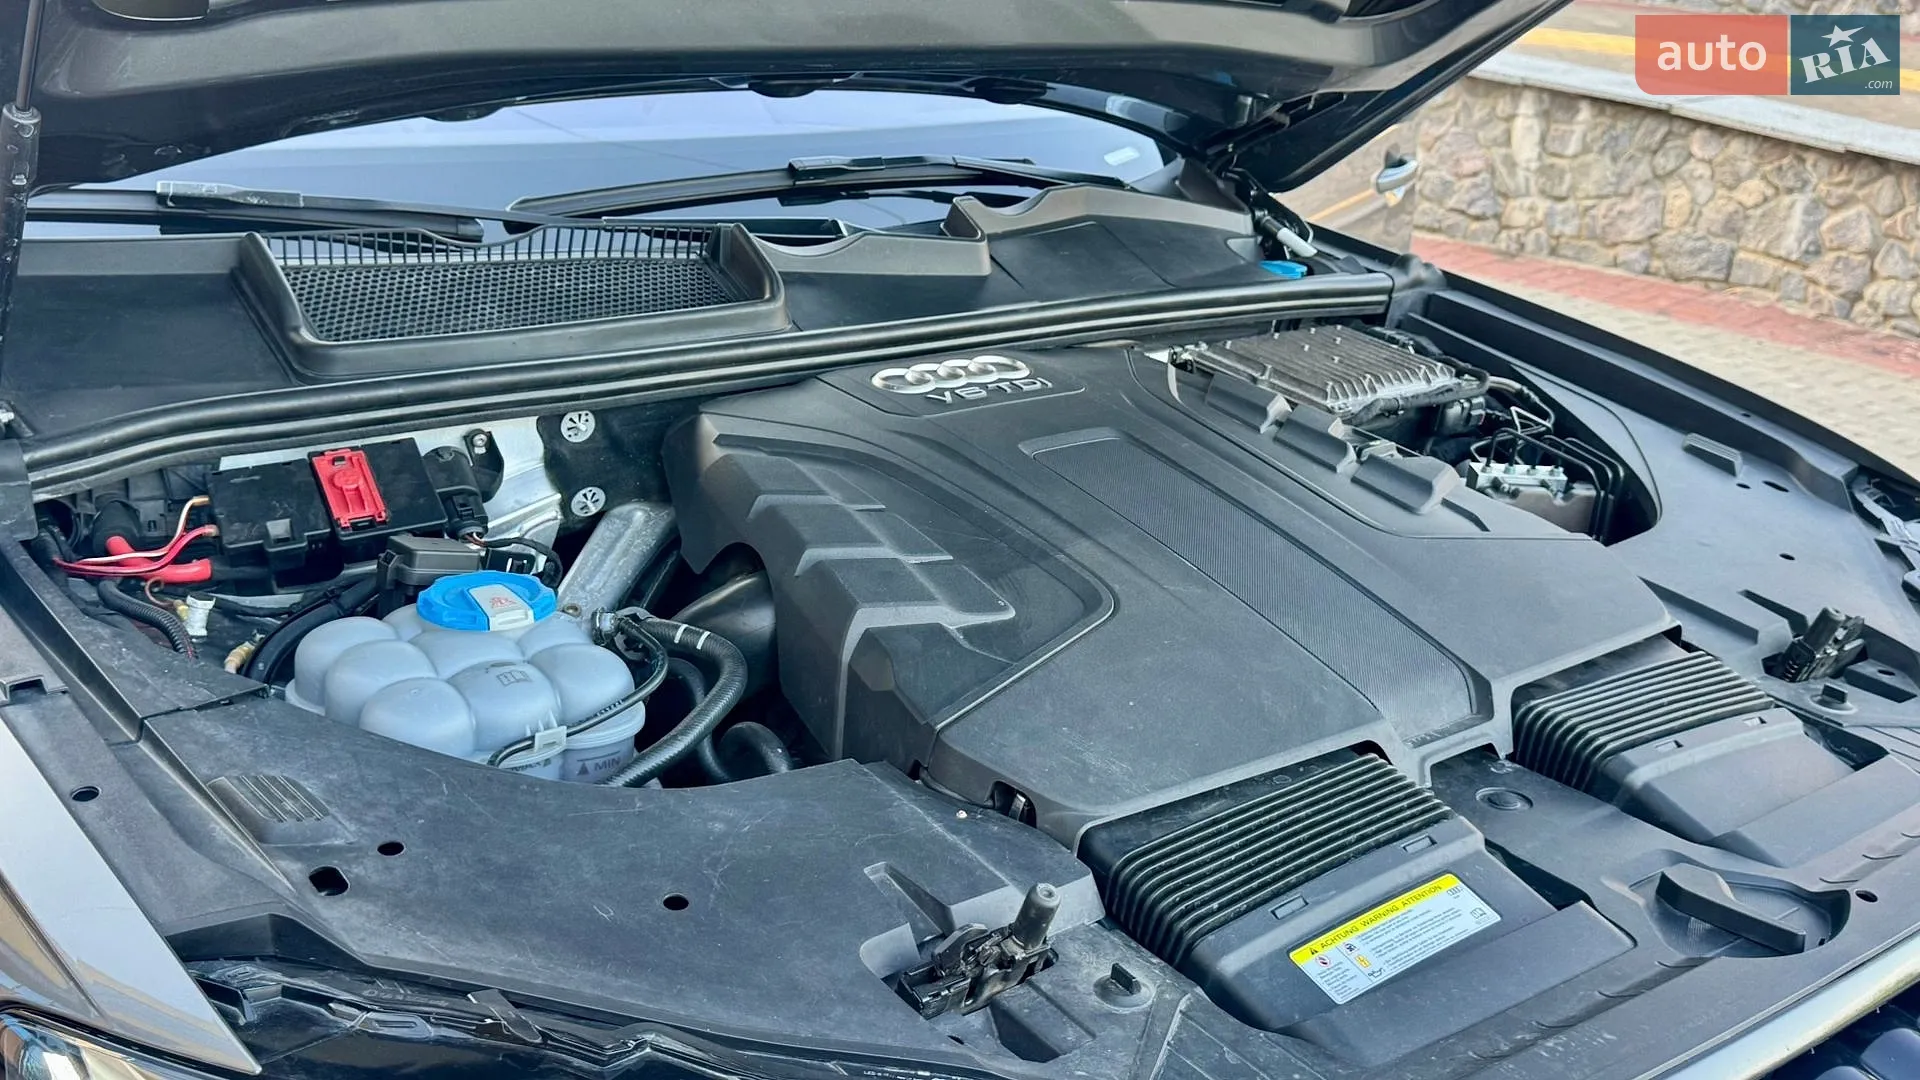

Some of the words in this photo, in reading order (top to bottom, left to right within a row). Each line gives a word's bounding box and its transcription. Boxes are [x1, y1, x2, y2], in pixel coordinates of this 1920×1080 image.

[926, 386, 987, 404] V6
[986, 377, 1053, 394] TDI
[594, 757, 621, 772] MIN
[1320, 925, 1360, 949] ACHTUNG
[1361, 905, 1399, 927] WARNING
[1402, 885, 1442, 907] ATTENTION
